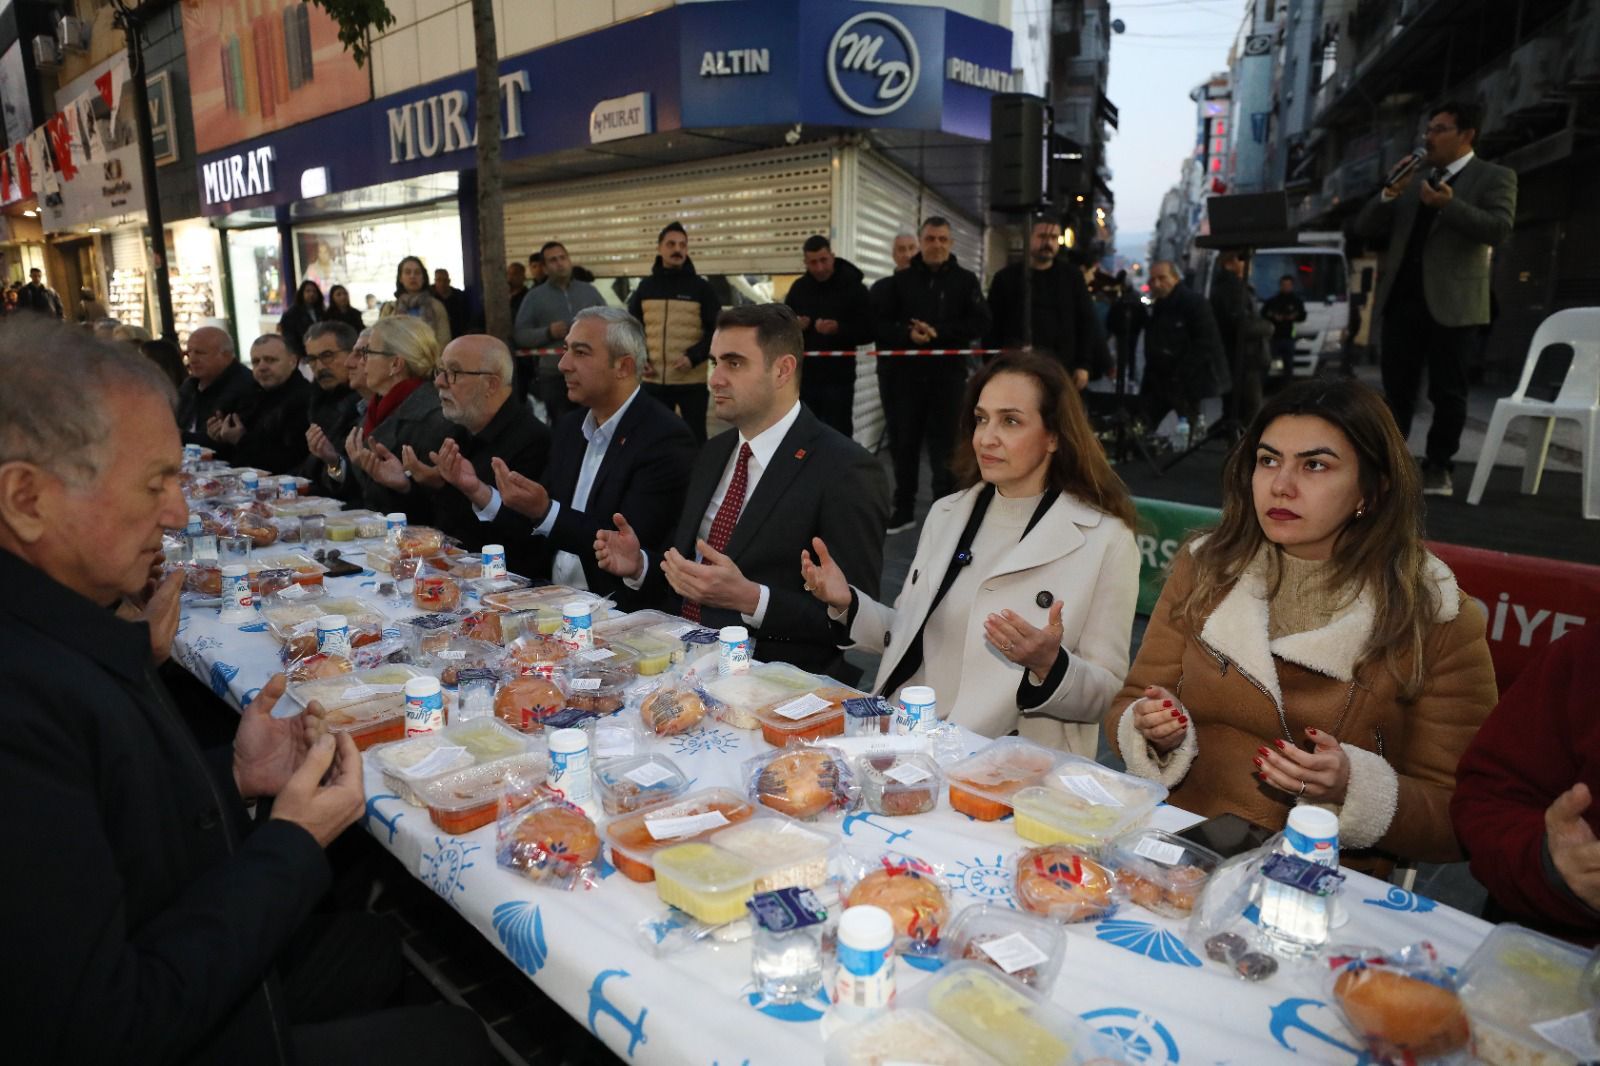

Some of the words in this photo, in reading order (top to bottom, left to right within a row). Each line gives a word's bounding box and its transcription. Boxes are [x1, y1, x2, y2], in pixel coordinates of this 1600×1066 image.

[700, 48, 770, 76] ALTIN
[387, 70, 531, 164] MURT
[203, 145, 275, 205] MURAT
